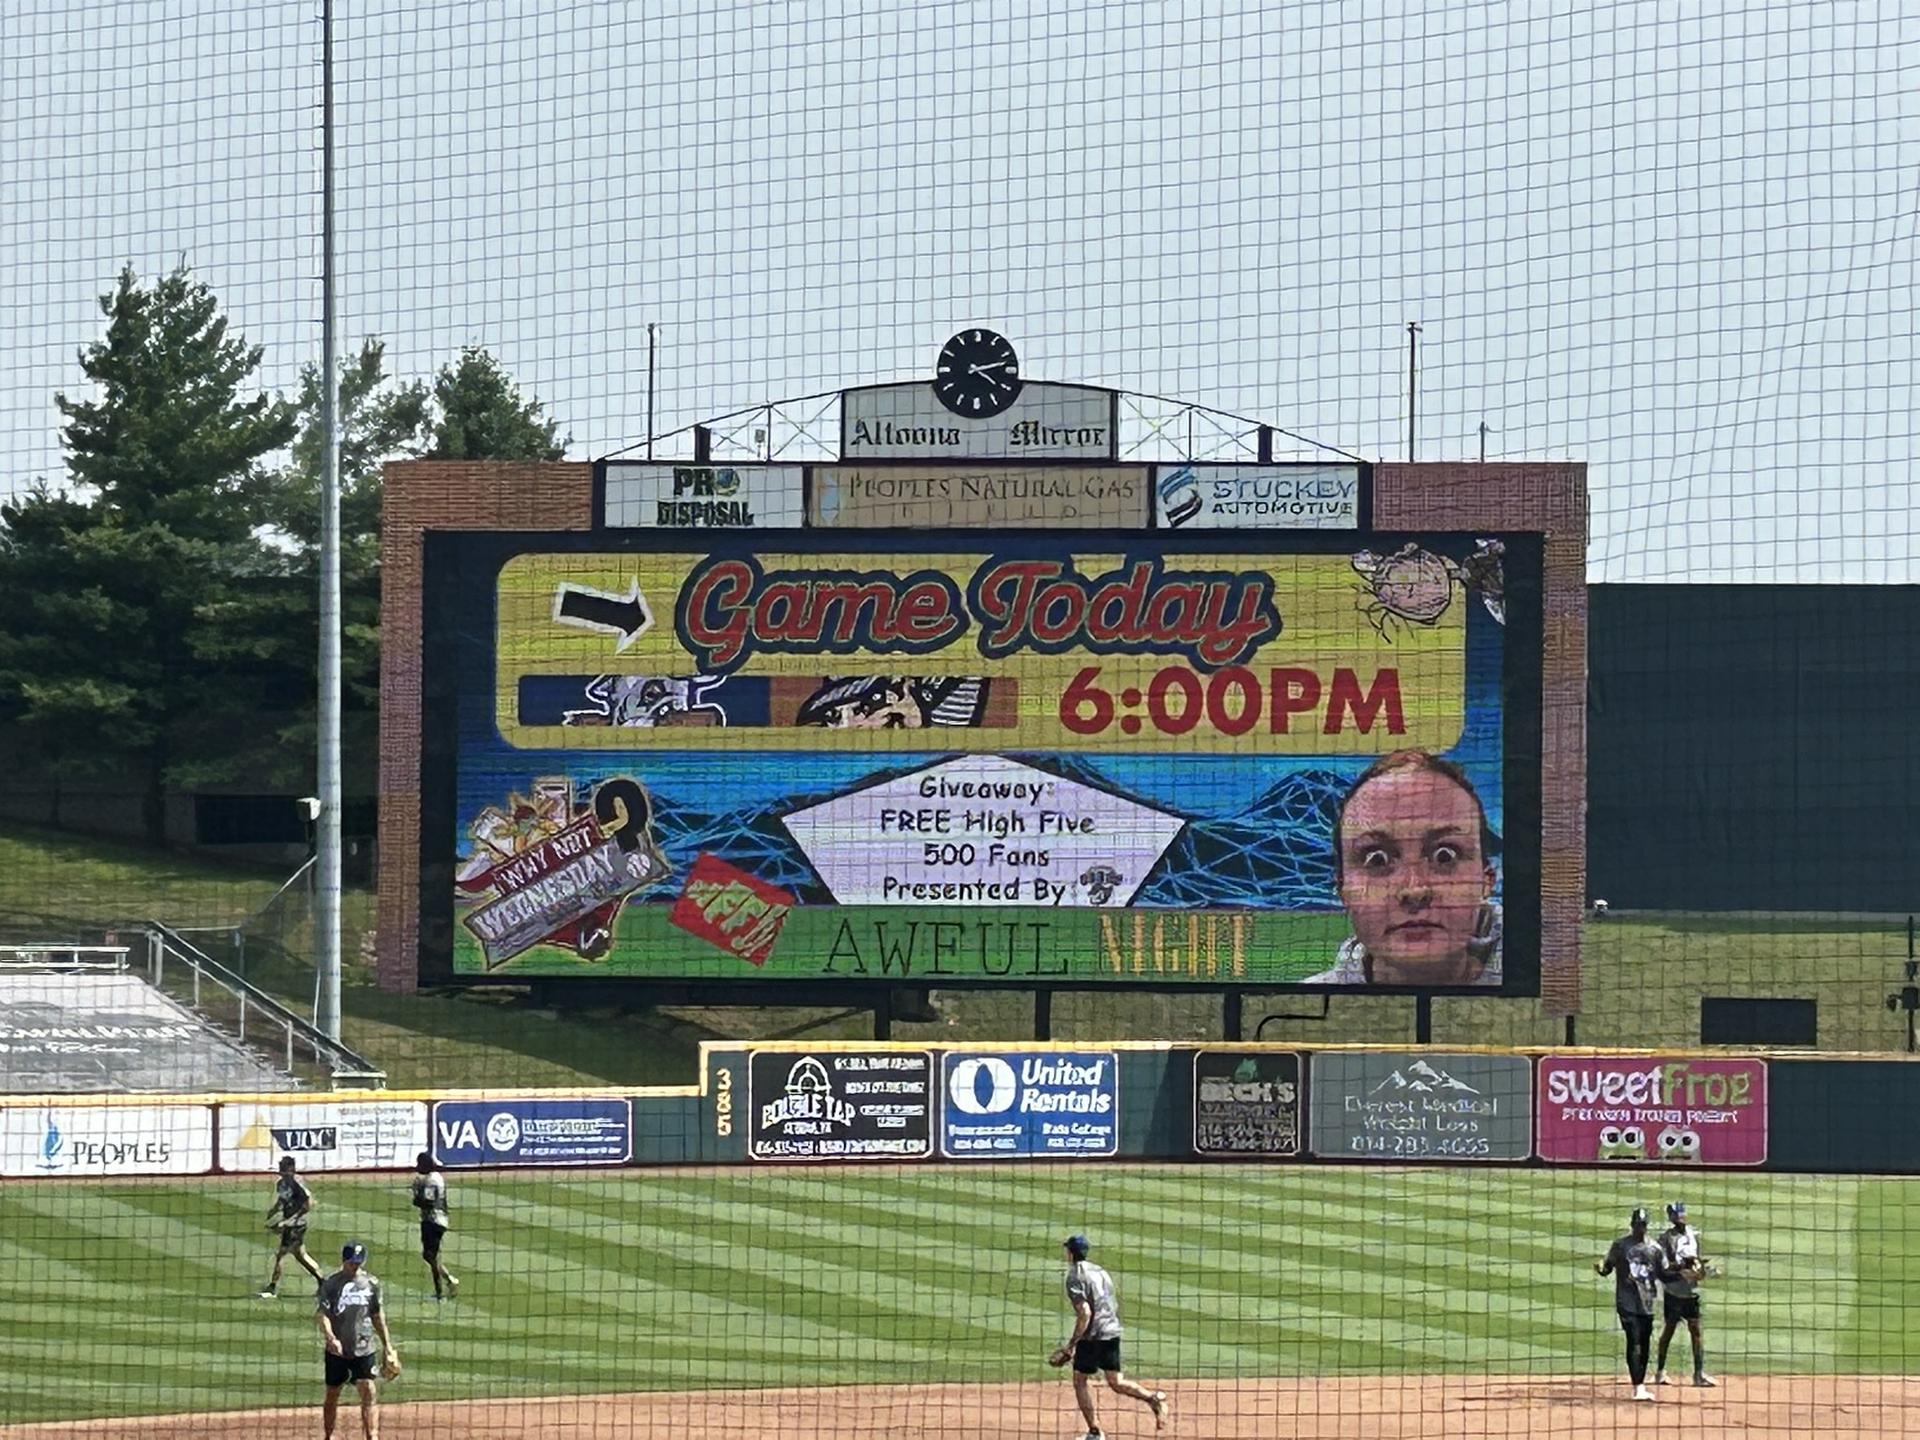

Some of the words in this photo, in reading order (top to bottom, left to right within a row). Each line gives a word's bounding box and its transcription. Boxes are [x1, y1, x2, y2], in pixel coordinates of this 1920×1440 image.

[851, 419, 961, 446] Altoona
[1010, 419, 1107, 447] Mirror
[673, 467, 741, 497] PRO
[850, 476, 950, 499] PEOPLES
[960, 475, 1076, 499] NATURAL
[1084, 475, 1134, 499] GAS
[1213, 479, 1357, 499] STUCKEY
[657, 501, 755, 526] DISPOSAL
[1212, 501, 1352, 515] AUTOMOTIVE
[686, 560, 958, 664] Game
[978, 560, 1268, 664] Today
[1059, 666, 1407, 736] 6:00PM
[881, 809, 951, 834] FREE
[964, 809, 1026, 838] High
[1039, 810, 1096, 834] Five
[500, 847, 550, 891] WHY
[553, 825, 593, 862] NOT
[924, 844, 975, 866] 500
[988, 844, 1049, 866] Fans
[474, 843, 616, 939] WEDNESDAY
[883, 876, 1020, 901] Presented
[822, 917, 1069, 975] AWFUL
[1021, 1058, 1106, 1086] United
[1020, 1088, 1112, 1113] Rentals
[438, 1120, 481, 1150] VA
[73, 1141, 170, 1165] PEOPLES
